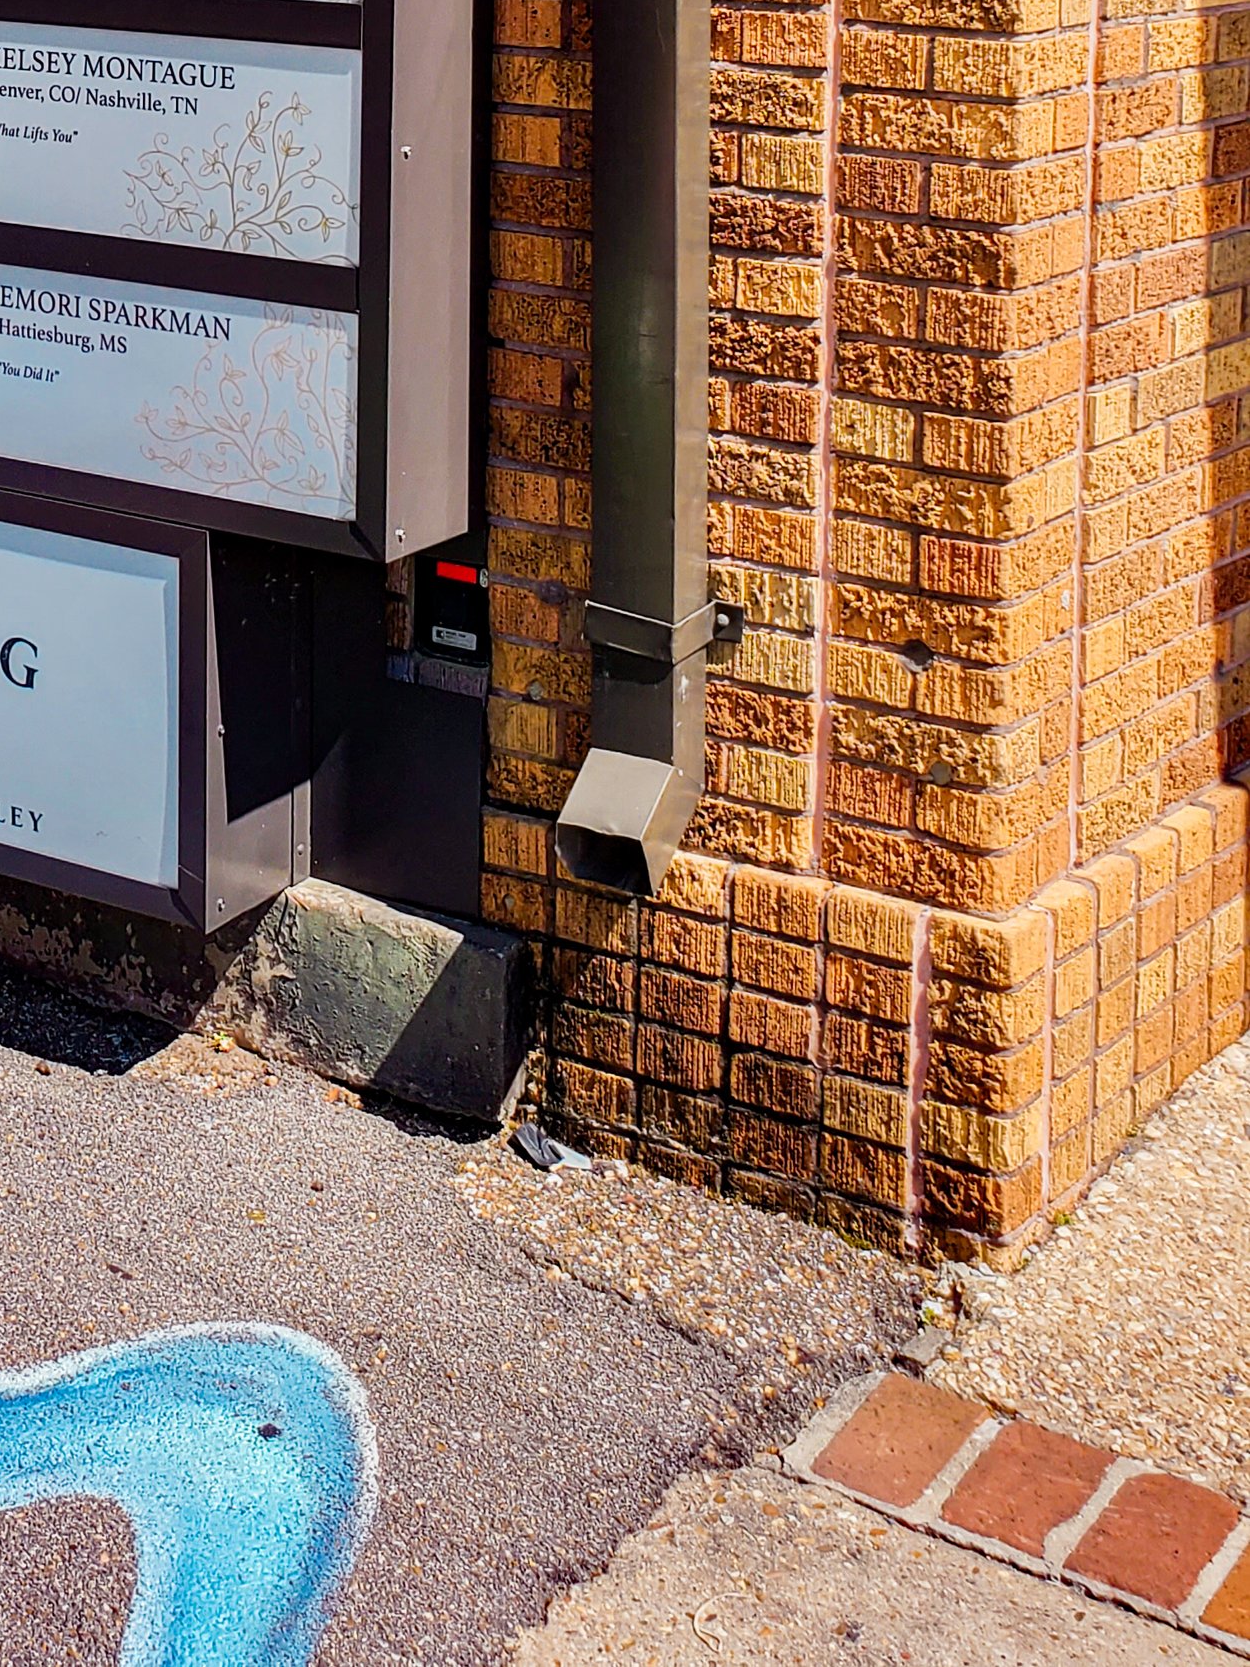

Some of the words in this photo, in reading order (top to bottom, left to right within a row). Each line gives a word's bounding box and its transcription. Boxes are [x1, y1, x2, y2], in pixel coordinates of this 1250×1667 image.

[83, 54, 235, 90] MONTAGUE
[49, 85, 81, 104] CO/
[86, 88, 166, 115] Nashville,
[170, 96, 198, 115] TN
[23, 126, 49, 143] Lifts
[0, 285, 81, 318] EMORI
[88, 298, 231, 341] SPARKMAN
[100, 333, 127, 354] MS
[23, 366, 43, 380] Did
